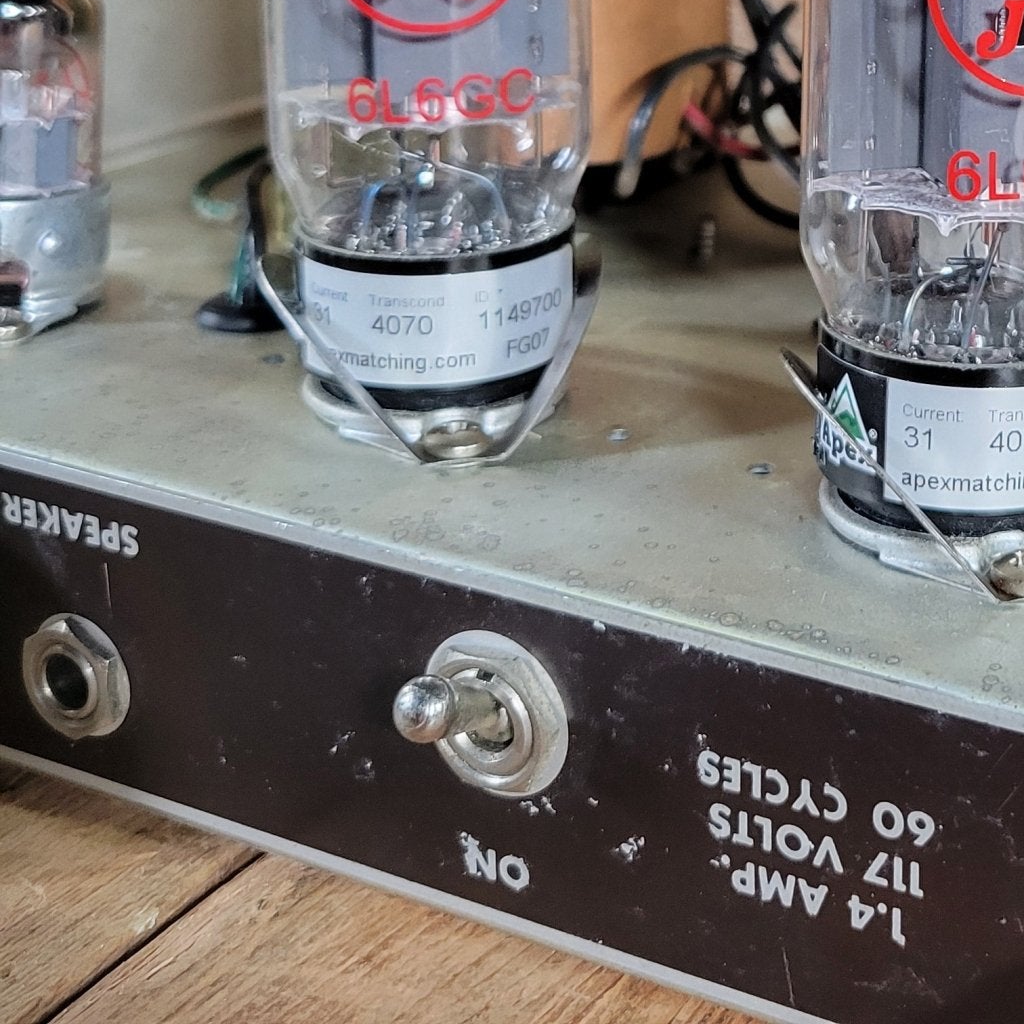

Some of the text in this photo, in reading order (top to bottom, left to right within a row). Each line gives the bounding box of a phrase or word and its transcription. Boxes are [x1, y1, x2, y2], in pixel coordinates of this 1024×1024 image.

[347, 67, 536, 124] 6L6GC
[368, 293, 445, 308] Transcond
[371, 314, 433, 335] 4070
[479, 287, 562, 330] 1149700
[507, 327, 550, 359] FG07
[904, 426, 931, 450] 31
[1, 491, 139, 559] SPEAKER
[699, 750, 936, 847] 60 CYCLES
[457, 831, 530, 892] ON
[708, 802, 925, 899] 117 VOLTS
[848, 893, 907, 947] 1.4
